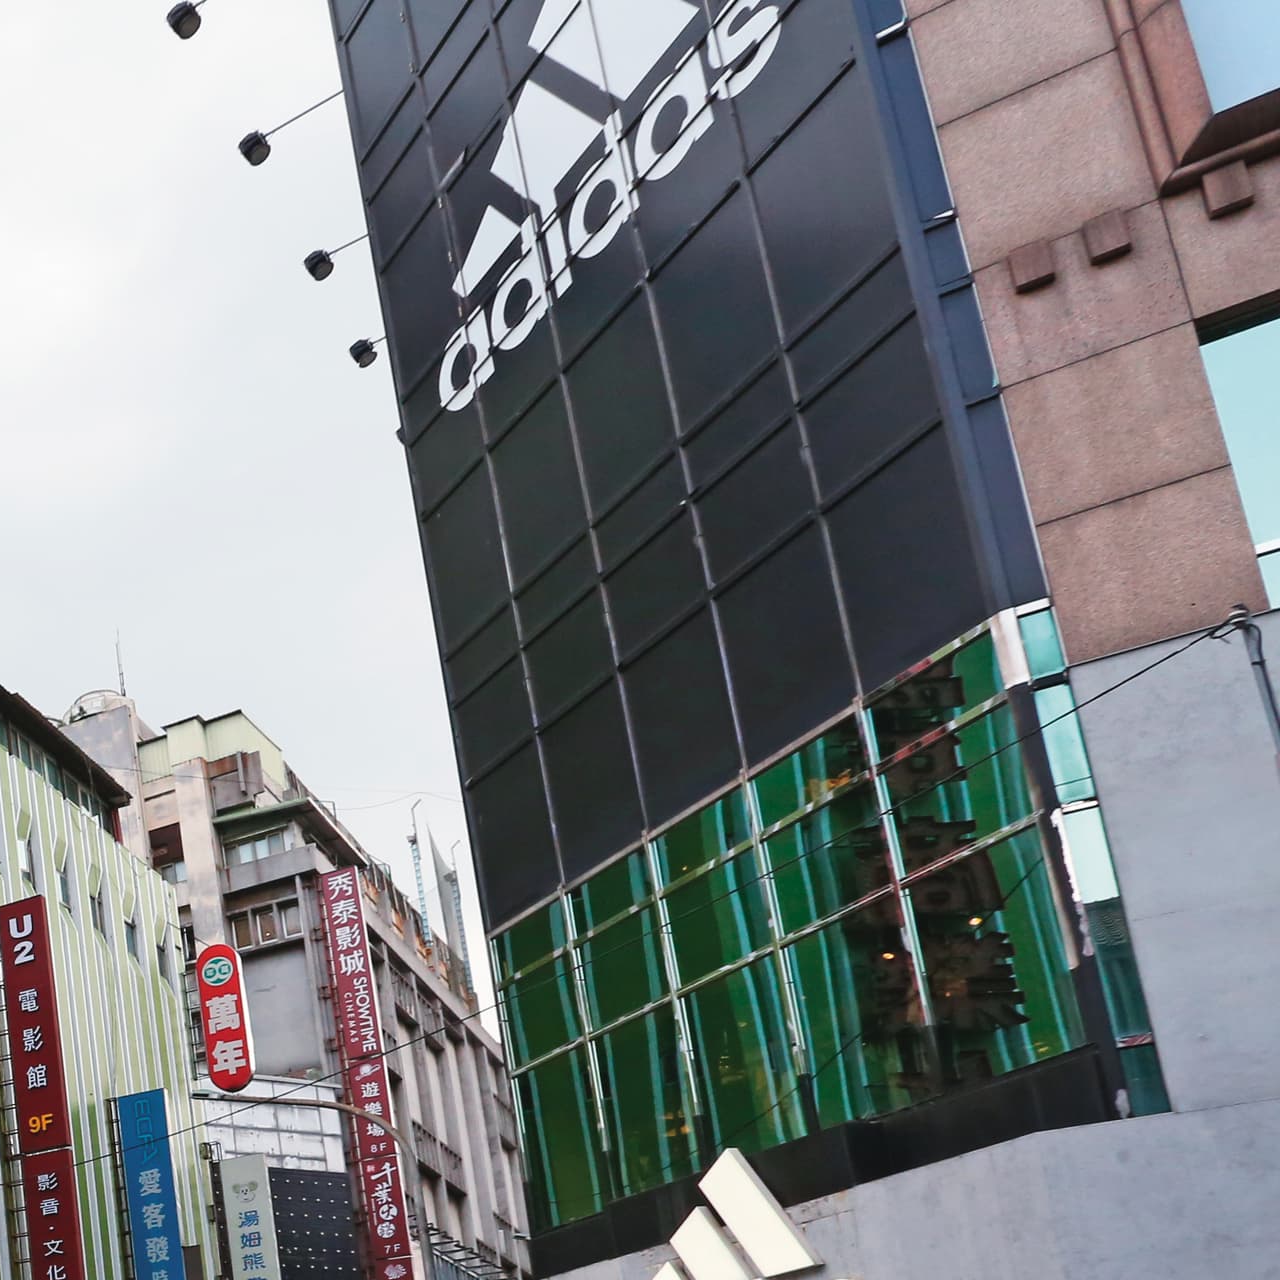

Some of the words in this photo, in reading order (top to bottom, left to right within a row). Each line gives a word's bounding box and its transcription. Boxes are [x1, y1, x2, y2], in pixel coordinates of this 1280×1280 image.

[438, 0, 782, 412] adidas
[8, 914, 35, 966] U2
[328, 872, 366, 976] 秀泰影城
[18, 988, 48, 1090] 電影館
[205, 993, 247, 1075] 萬年
[344, 993, 360, 1044] CINEMAS
[353, 977, 377, 1053] SHOWTIME
[28, 1113, 54, 1134] 9F
[360, 1081, 385, 1136] 遊樂場
[370, 1143, 387, 1153] 8F
[138, 1168, 169, 1263] 愛客發
[384, 1243, 401, 1254] 7F
